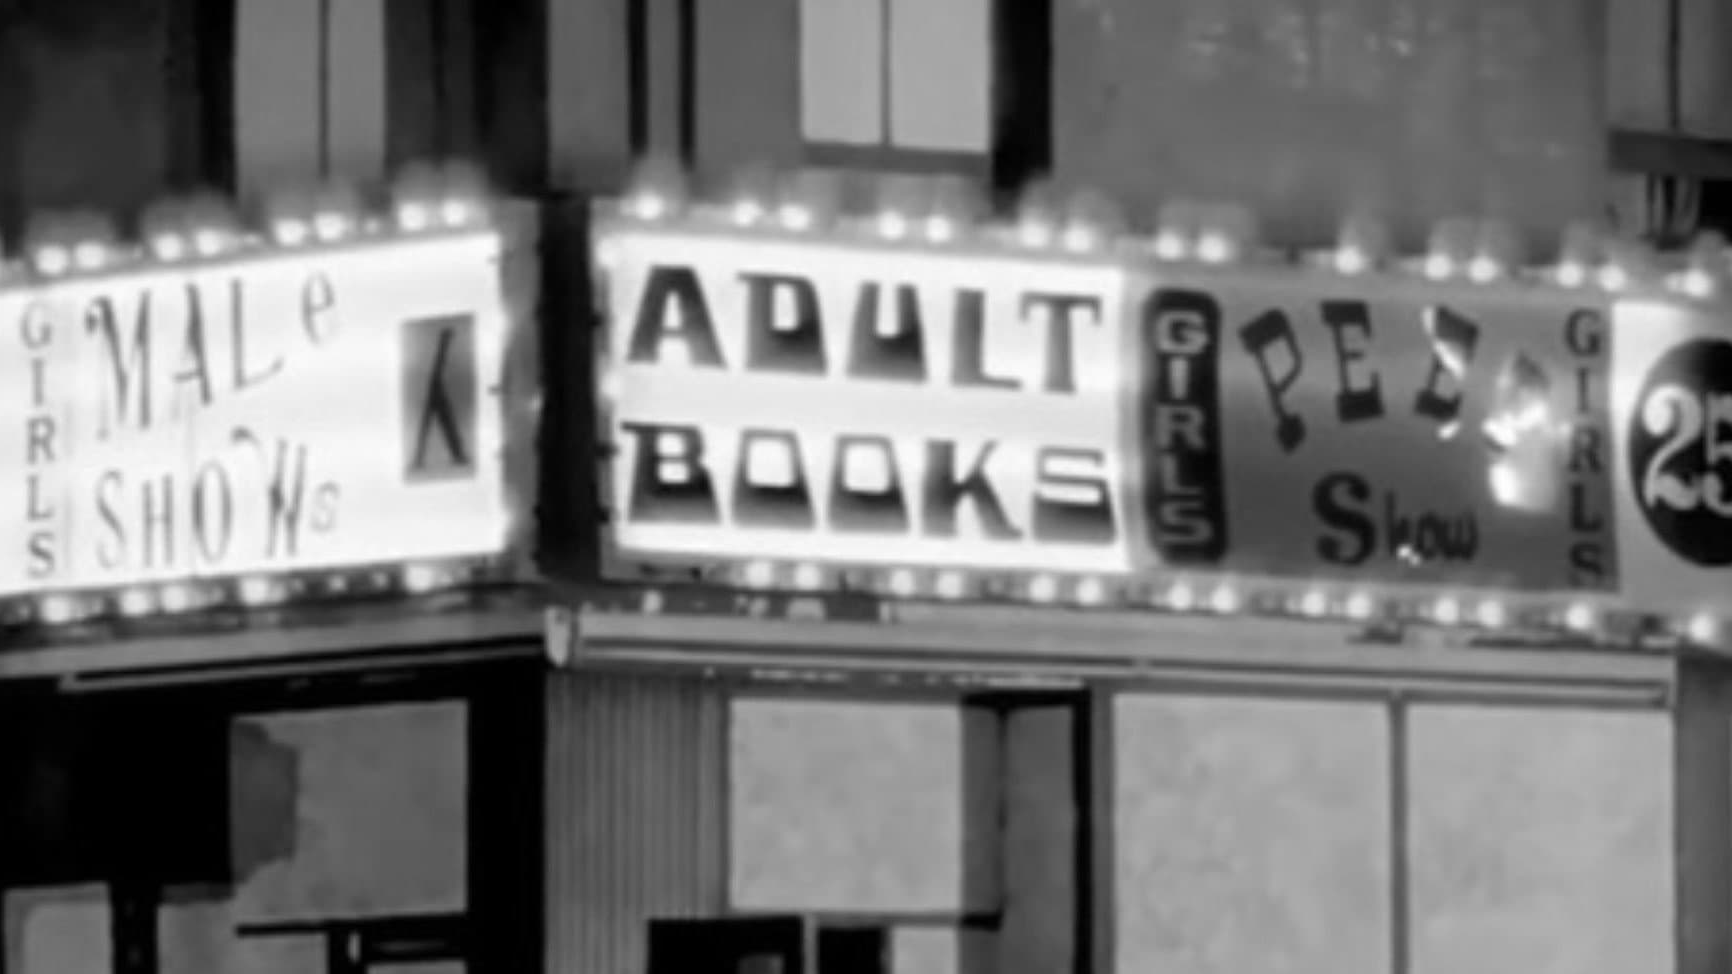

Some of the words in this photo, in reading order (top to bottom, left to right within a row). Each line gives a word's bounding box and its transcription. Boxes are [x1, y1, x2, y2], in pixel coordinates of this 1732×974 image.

[19, 302, 56, 579] GIRLS
[625, 265, 1102, 394] ADULT
[1155, 309, 1215, 546] GIRLS
[620, 422, 1118, 545] BOOKS
[1564, 308, 1604, 589] GIRLS
